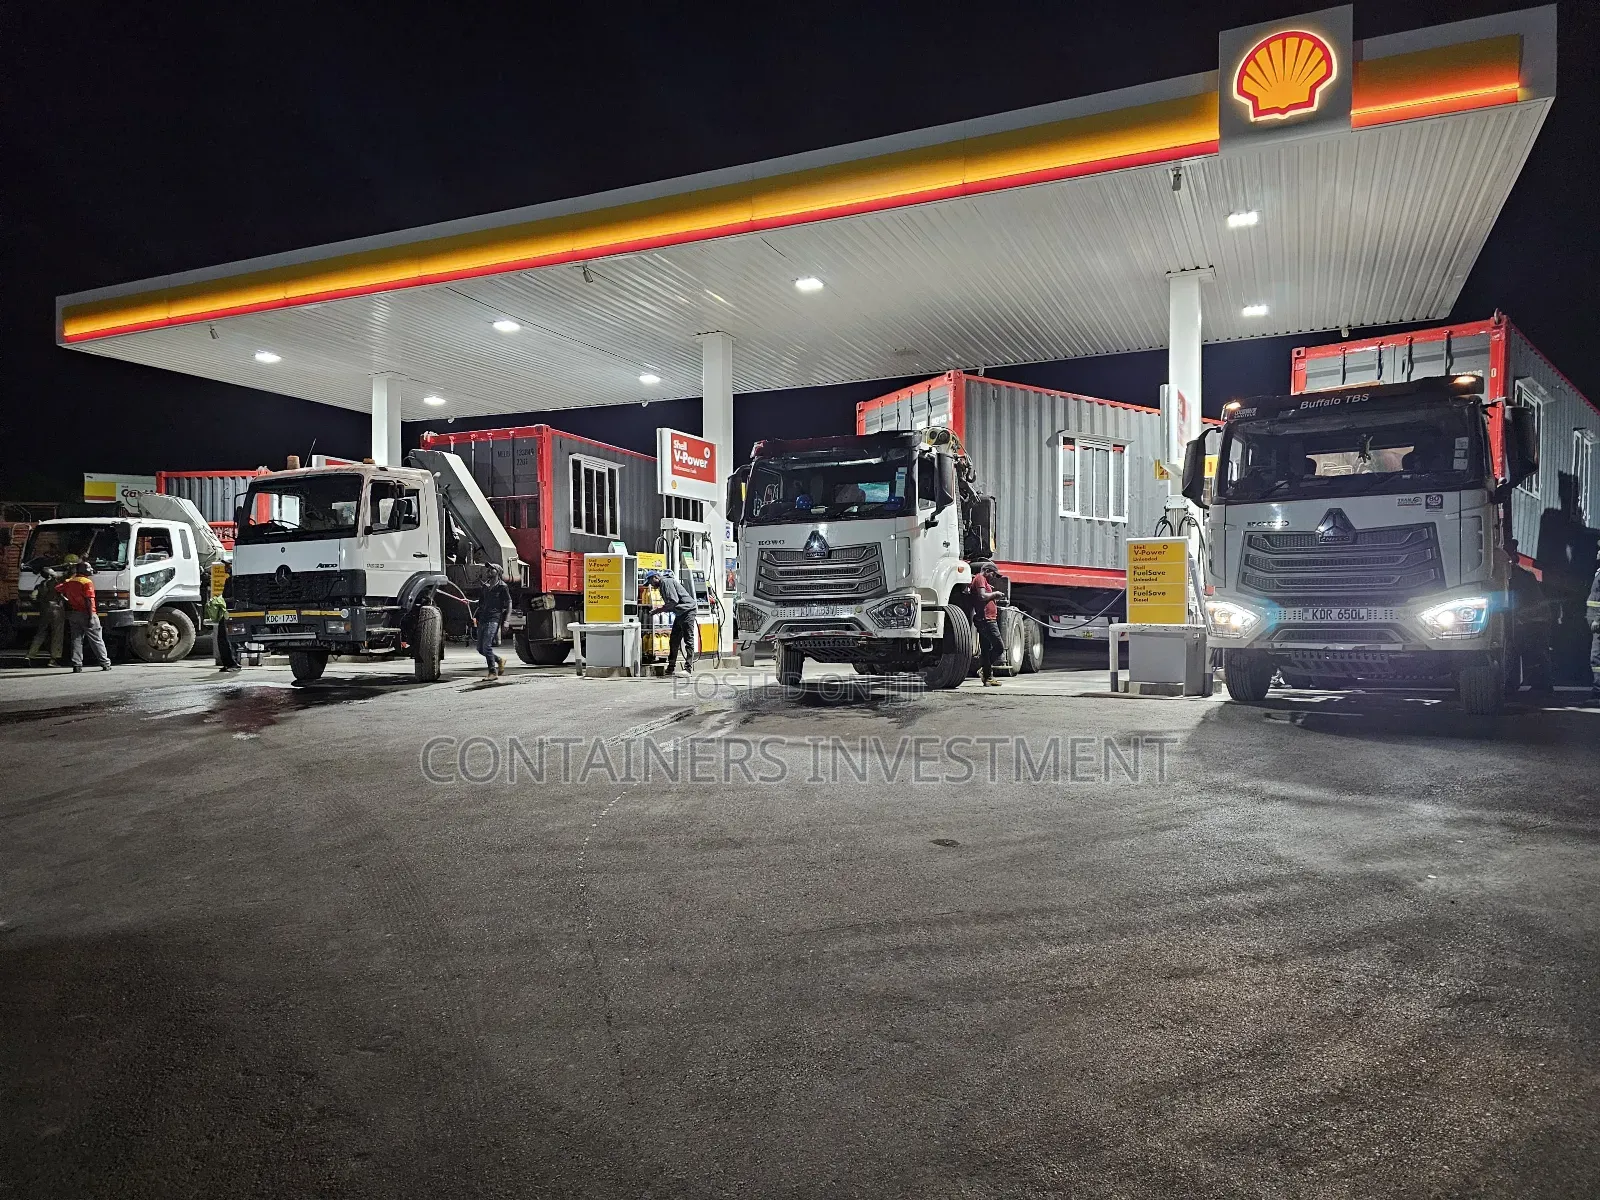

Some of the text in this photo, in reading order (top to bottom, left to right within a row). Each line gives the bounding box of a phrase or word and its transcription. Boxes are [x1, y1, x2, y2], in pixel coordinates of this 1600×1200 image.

[1299, 393, 1370, 410] Buffalo TBS
[673, 439, 688, 451] Shell
[673, 448, 708, 469] V-Power
[1312, 609, 1365, 620] KDR 650L
